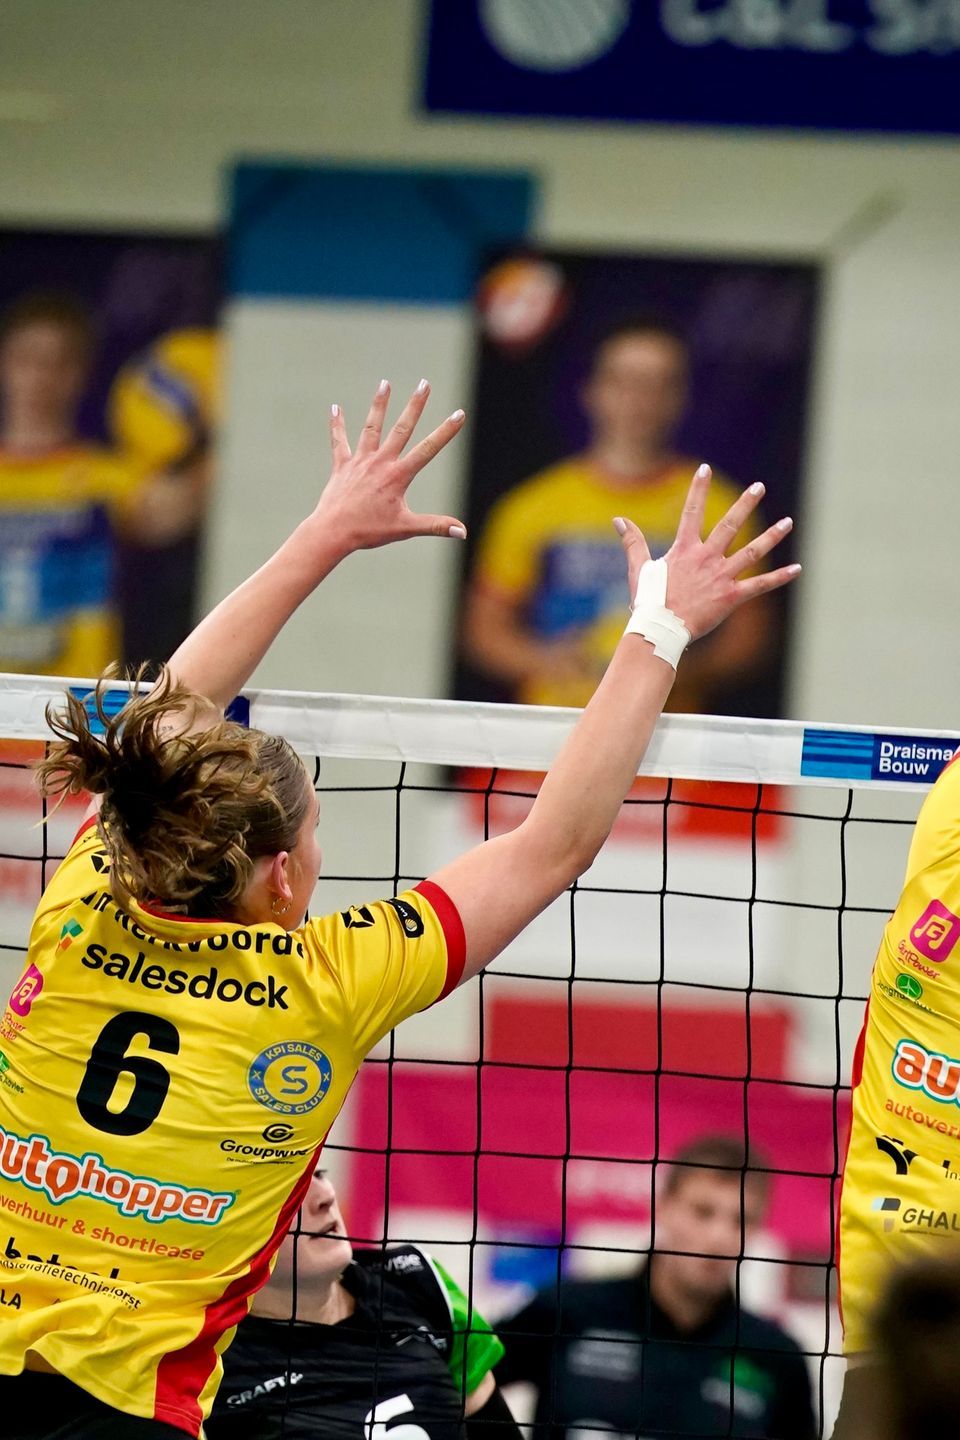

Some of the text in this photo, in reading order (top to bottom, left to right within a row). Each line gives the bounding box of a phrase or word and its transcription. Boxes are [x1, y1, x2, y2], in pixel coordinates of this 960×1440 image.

[880, 742, 953, 761] Draisma
[879, 757, 930, 775] Bouw
[81, 943, 290, 1010] salesdock
[265, 1043, 322, 1062] KPI SALES
[76, 1011, 180, 1136] 6
[254, 1087, 325, 1113] SALES CLUB
[0, 1194, 68, 1230] verhuur
[72, 1219, 86, 1236] &
[90, 1227, 205, 1261] shortlease
